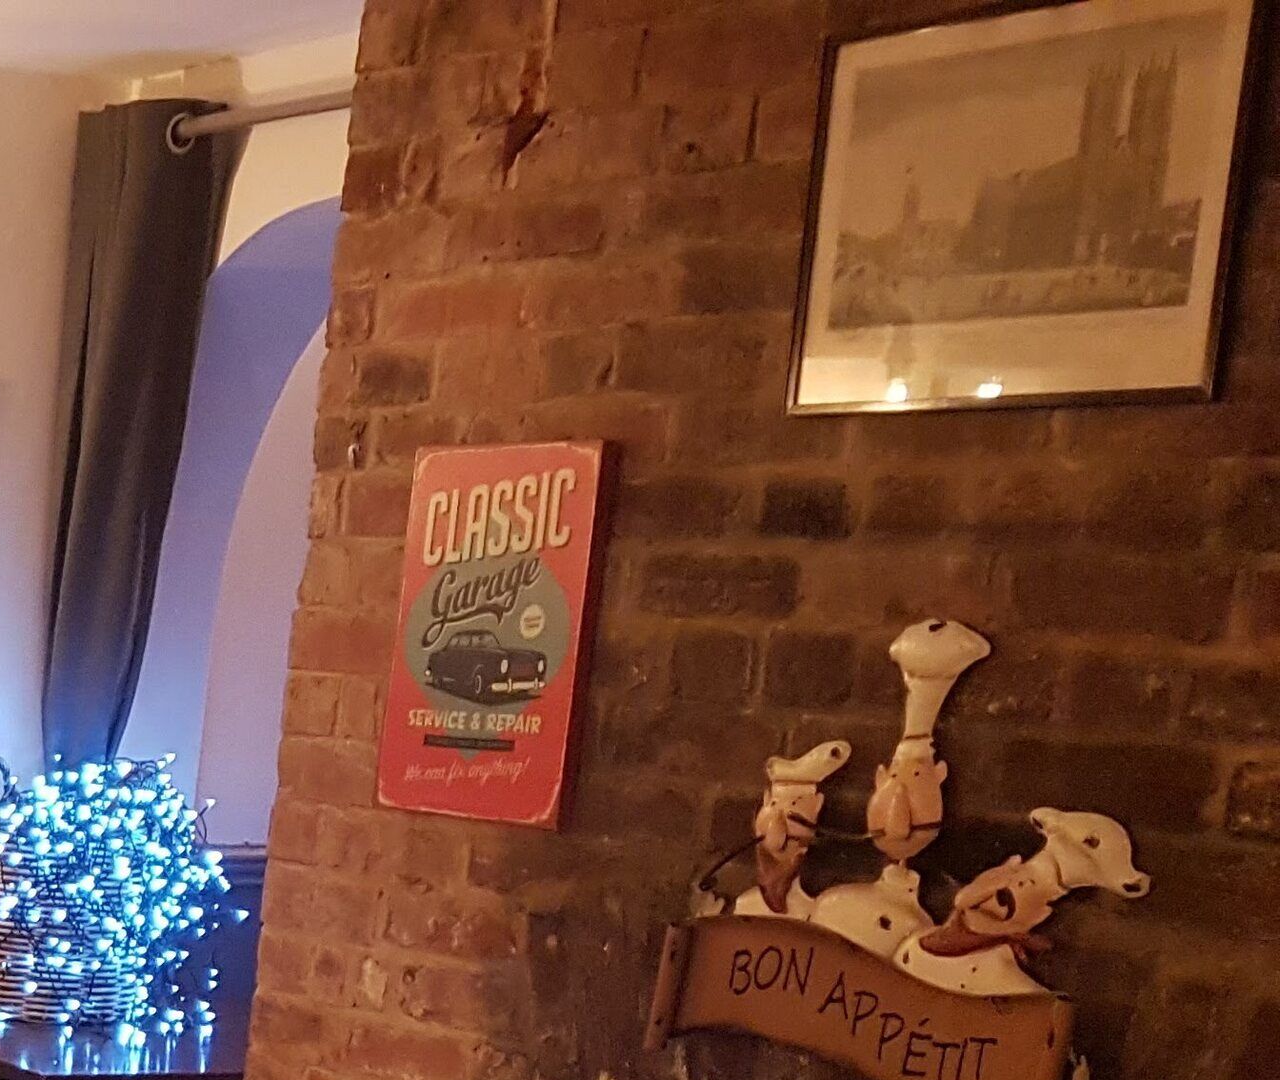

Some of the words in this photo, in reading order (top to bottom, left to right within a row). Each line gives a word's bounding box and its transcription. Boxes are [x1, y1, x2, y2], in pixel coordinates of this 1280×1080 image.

[424, 468, 576, 567] CLASSIC
[422, 557, 540, 648] Garage
[408, 709, 467, 730] SERVICE
[470, 712, 481, 731] &
[485, 713, 542, 734] REPAIR
[729, 945, 814, 996] BON
